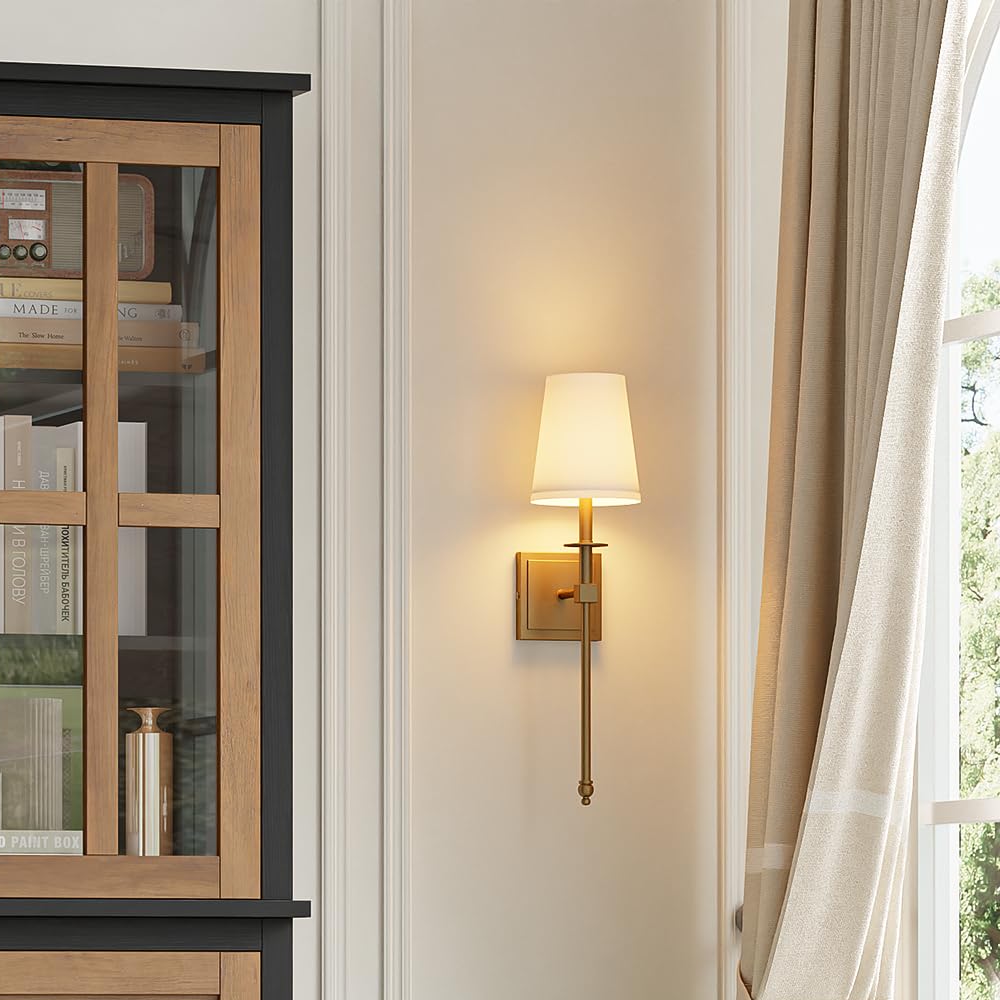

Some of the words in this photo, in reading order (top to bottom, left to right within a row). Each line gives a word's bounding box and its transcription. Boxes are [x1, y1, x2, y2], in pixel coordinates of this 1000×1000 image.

[13, 303, 58, 315] MADE
[12, 551, 26, 605] ГОЛОВУ
[61, 582, 70, 622] БАБОЧЕК
[11, 835, 49, 848] PAINT
[54, 836, 80, 849] BOX
